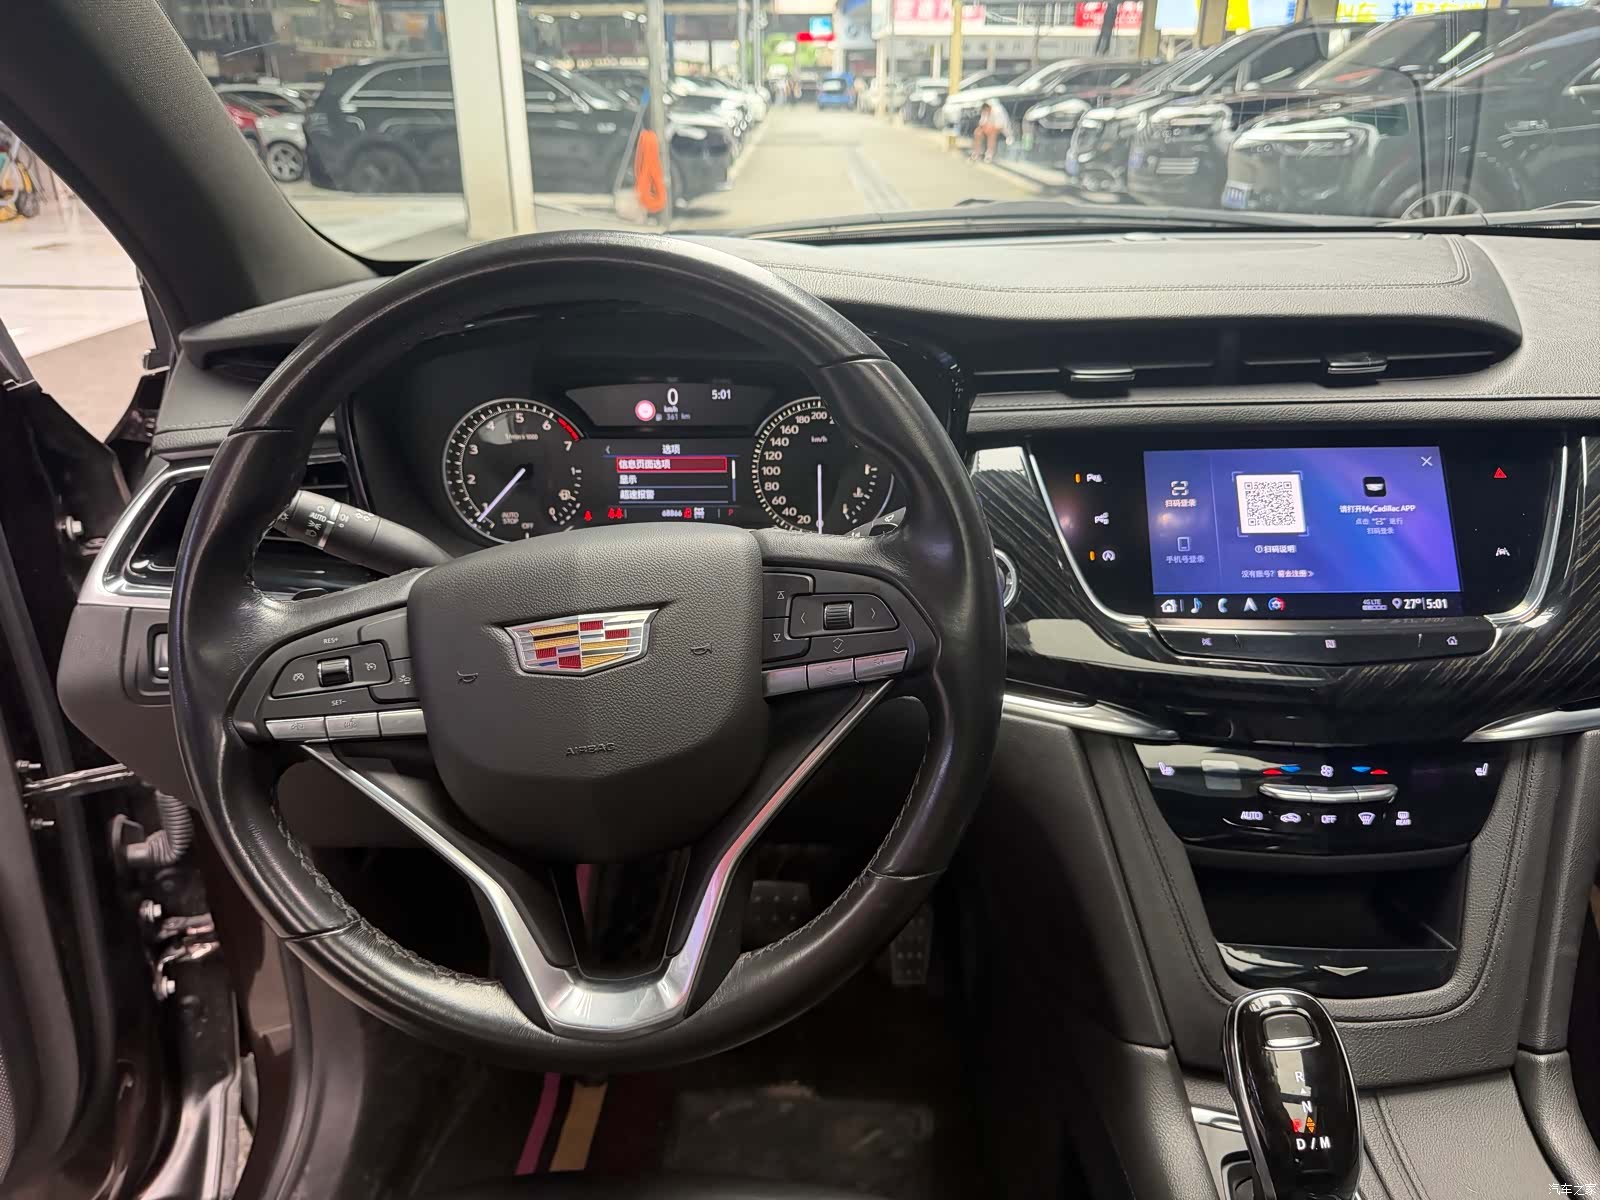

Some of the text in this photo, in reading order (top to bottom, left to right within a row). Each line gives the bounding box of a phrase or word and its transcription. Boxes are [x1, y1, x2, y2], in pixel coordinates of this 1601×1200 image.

[667, 388, 679, 406] 0
[711, 389, 731, 400] 5:01
[663, 405, 679, 413] km/h
[515, 413, 524, 424] 5
[666, 413, 678, 421] 361
[795, 415, 810, 424] 180
[810, 411, 827, 420] 200
[486, 421, 496, 431] 4
[542, 420, 552, 431] 6
[780, 425, 799, 435] 160
[770, 437, 789, 447] 140
[811, 435, 828, 443] km/h
[469, 444, 479, 455] 3
[564, 440, 572, 451] 7
[662, 444, 681, 455] 选项
[763, 451, 783, 461] 120
[618, 459, 671, 470] 信息页面选项
[761, 466, 781, 476] 100
[467, 474, 476, 485] 2
[619, 474, 637, 485] 显示
[764, 481, 779, 491] 80
[620, 489, 655, 500] 超速报警
[771, 495, 786, 506] 60
[1165, 499, 1197, 508] 扫码登录
[501, 511, 519, 519] AUTO
[781, 507, 797, 516] 40
[310, 511, 327, 523] AUTO
[796, 514, 811, 524] 20
[1263, 545, 1297, 554] 扫码说明
[1165, 555, 1205, 564] 手机号登录
[1426, 599, 1448, 609] 5:01
[323, 636, 340, 645] RES+
[566, 742, 616, 756] AIRBAG
[1240, 811, 1264, 821] AUTO
[1320, 814, 1338, 825] OFF
[1294, 1071, 1305, 1083] R
[1301, 1100, 1313, 1113] N
